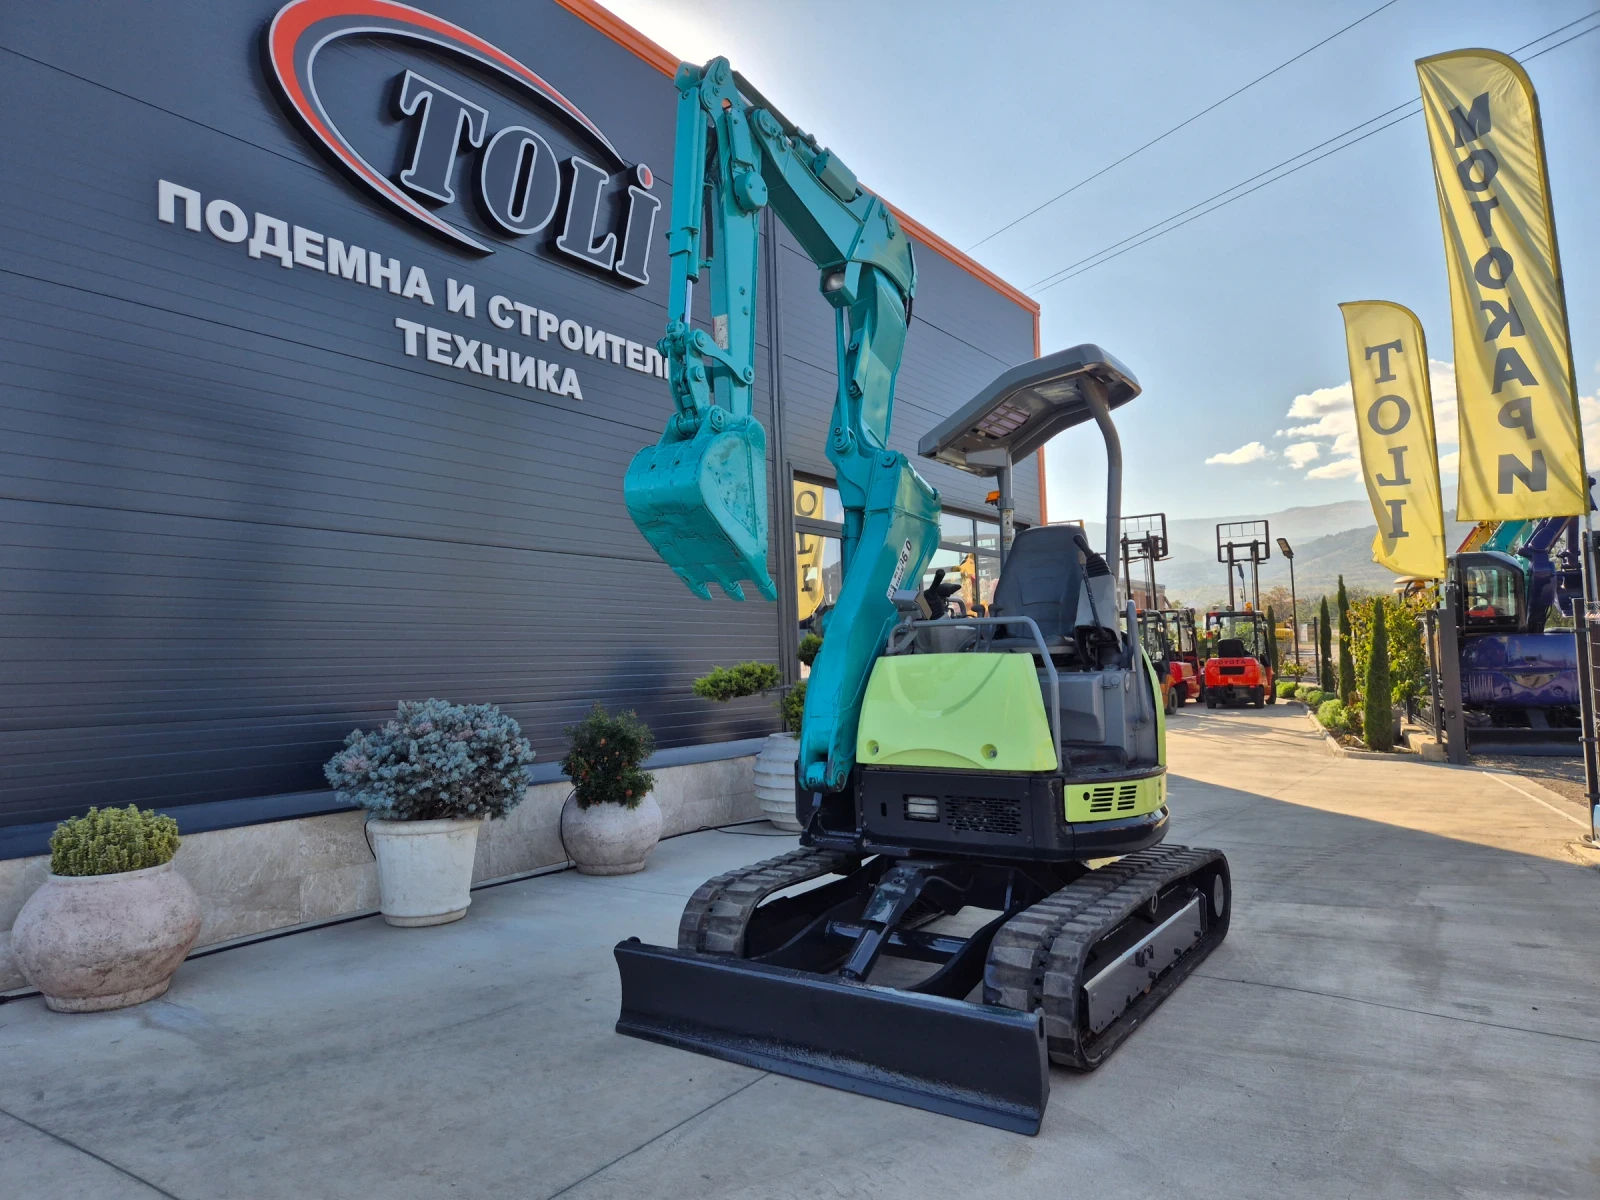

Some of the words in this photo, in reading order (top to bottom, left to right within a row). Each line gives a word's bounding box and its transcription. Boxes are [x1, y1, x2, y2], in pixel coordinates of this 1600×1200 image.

[158, 179, 435, 305] ПОДЕМНА
[446, 278, 476, 318] И
[488, 294, 669, 380] СТРОИТЕЛ
[395, 318, 584, 400] ТЕХНИКА
